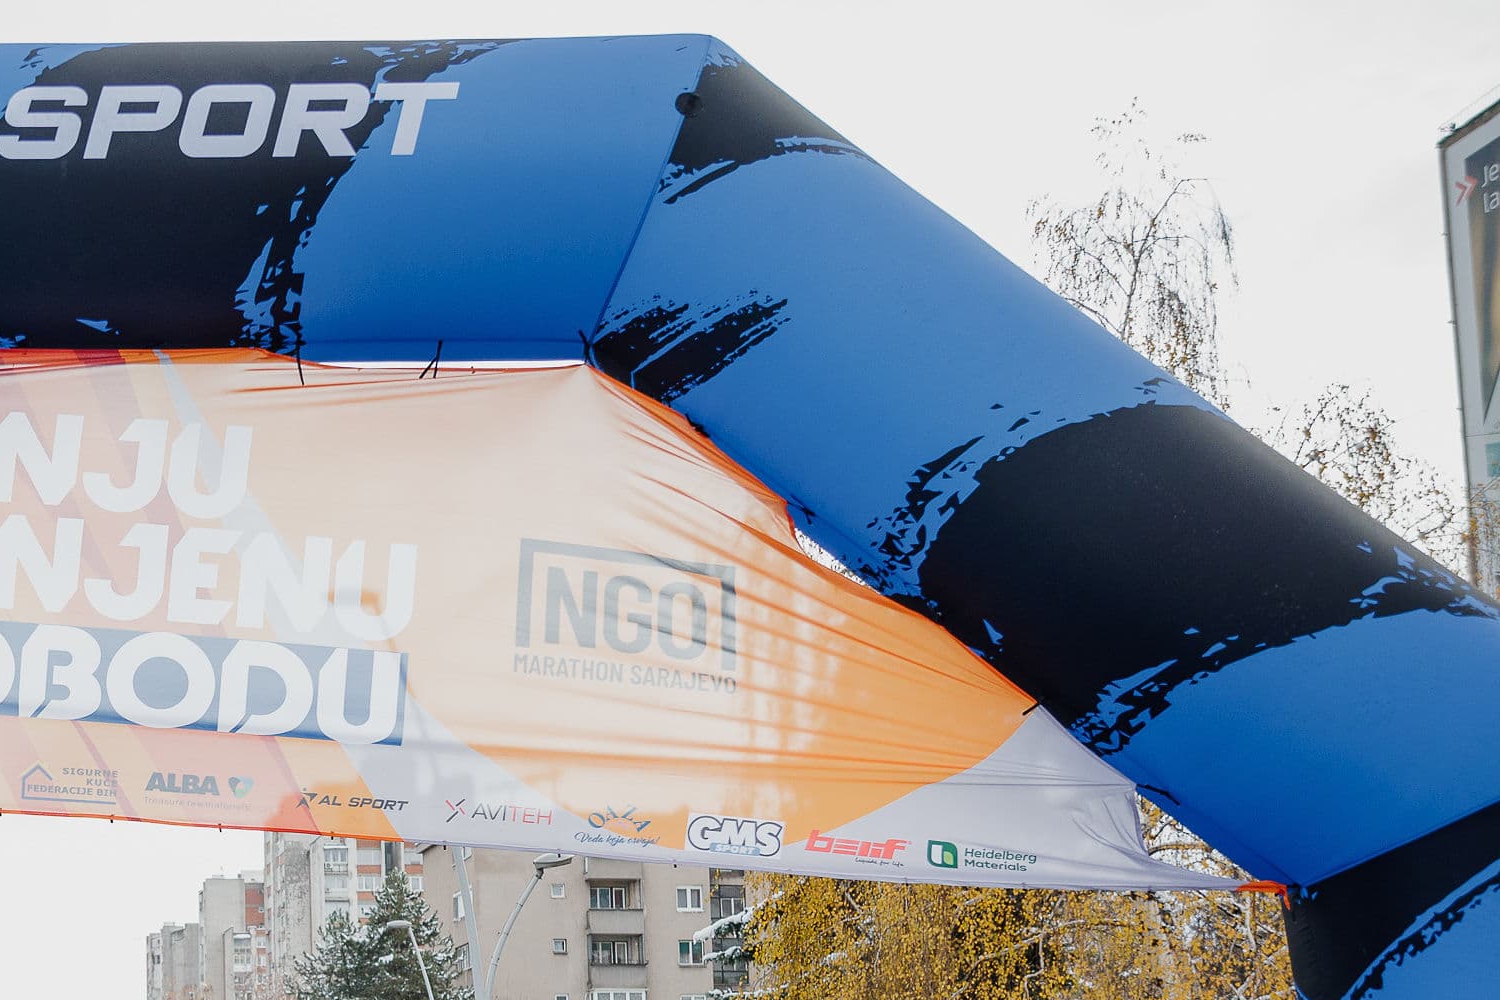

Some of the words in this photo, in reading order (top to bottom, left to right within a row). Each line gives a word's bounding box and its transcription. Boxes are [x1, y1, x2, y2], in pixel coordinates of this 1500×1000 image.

[513, 653, 624, 685] MARATHON
[629, 664, 737, 695] SARAJEVO
[61, 766, 119, 778] SIGURNE
[27, 784, 95, 797] FEDERACIJE
[144, 771, 221, 796] ALBA
[318, 794, 343, 807] AL
[348, 796, 409, 811] SPORT
[470, 801, 553, 826] AVITEH
[688, 815, 784, 857] GMS
[713, 844, 758, 856] SPORT
[964, 847, 1038, 865] Heidelberg
[964, 858, 1028, 872] Materials
